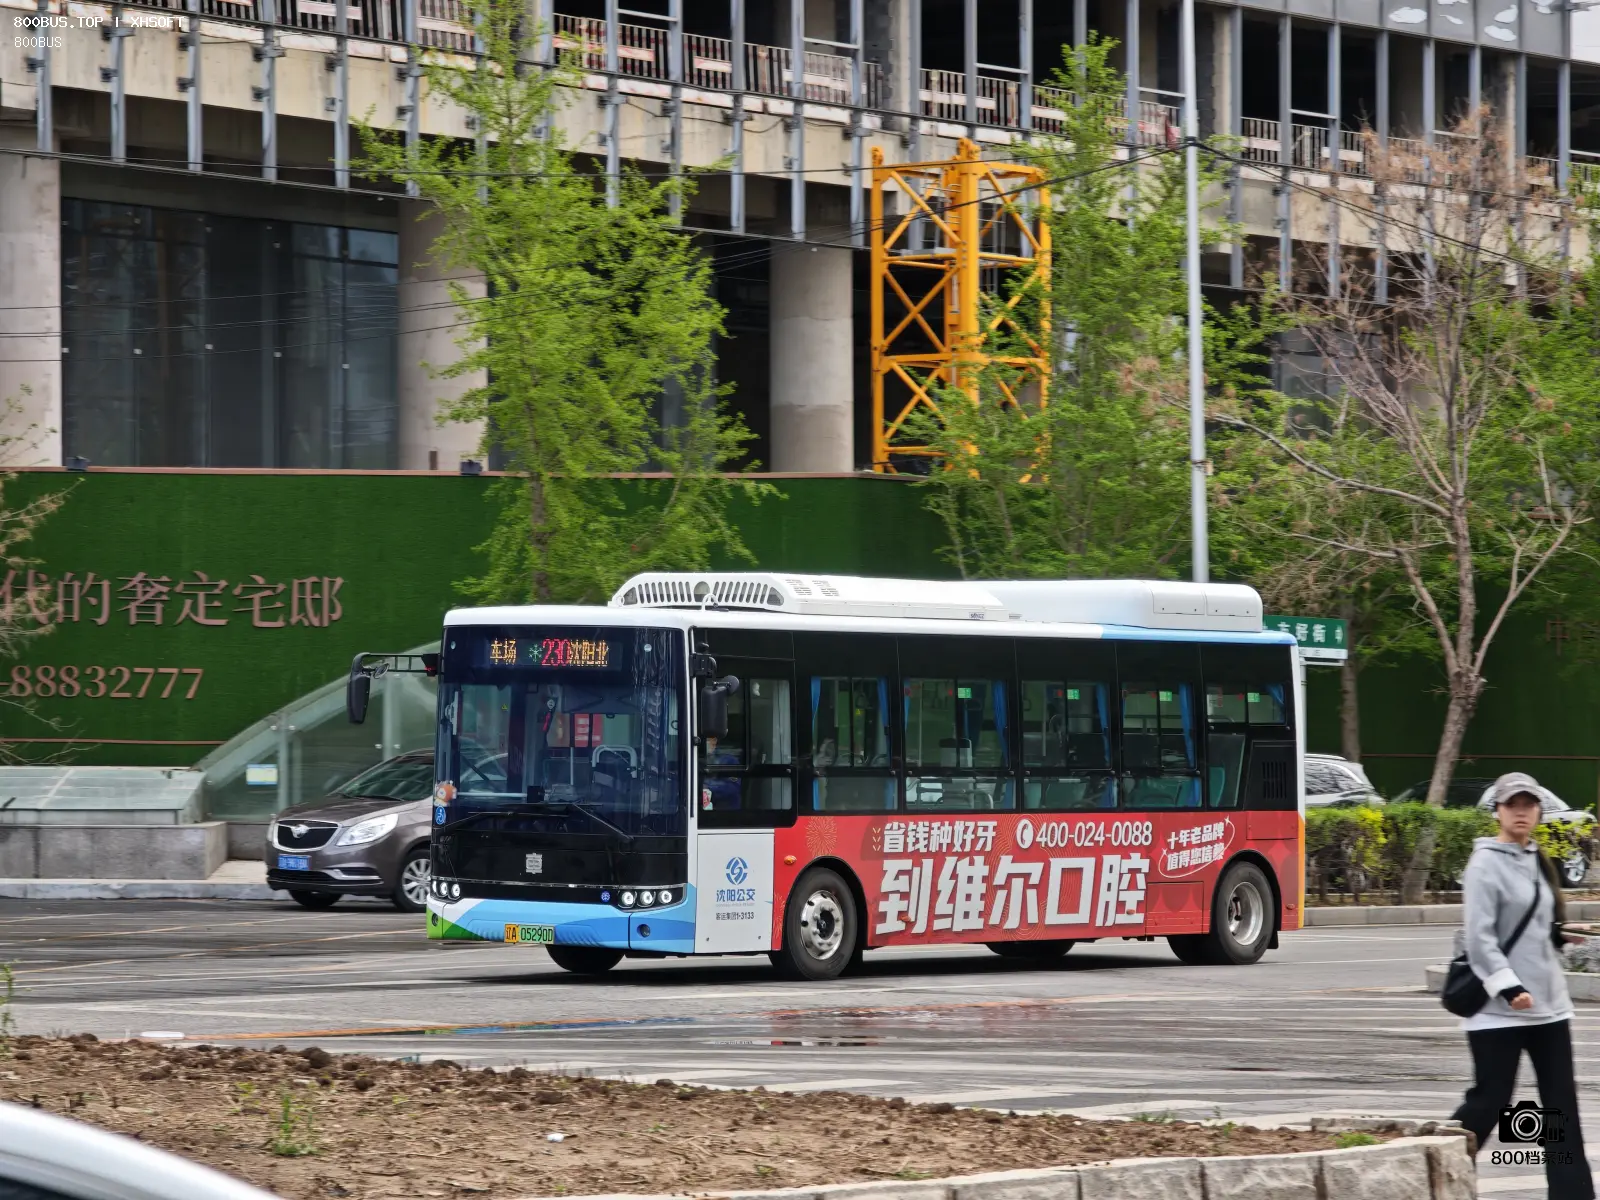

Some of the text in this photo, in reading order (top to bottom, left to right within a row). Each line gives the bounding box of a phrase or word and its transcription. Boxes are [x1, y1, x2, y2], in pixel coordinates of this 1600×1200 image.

[541, 638, 570, 666] 230
[883, 820, 1153, 852] 省钱种好牙 400-024-0088
[1167, 822, 1225, 849] 十年老品牌
[716, 888, 756, 902] 沈阳公交
[876, 853, 1150, 935] 到维尔口腔
